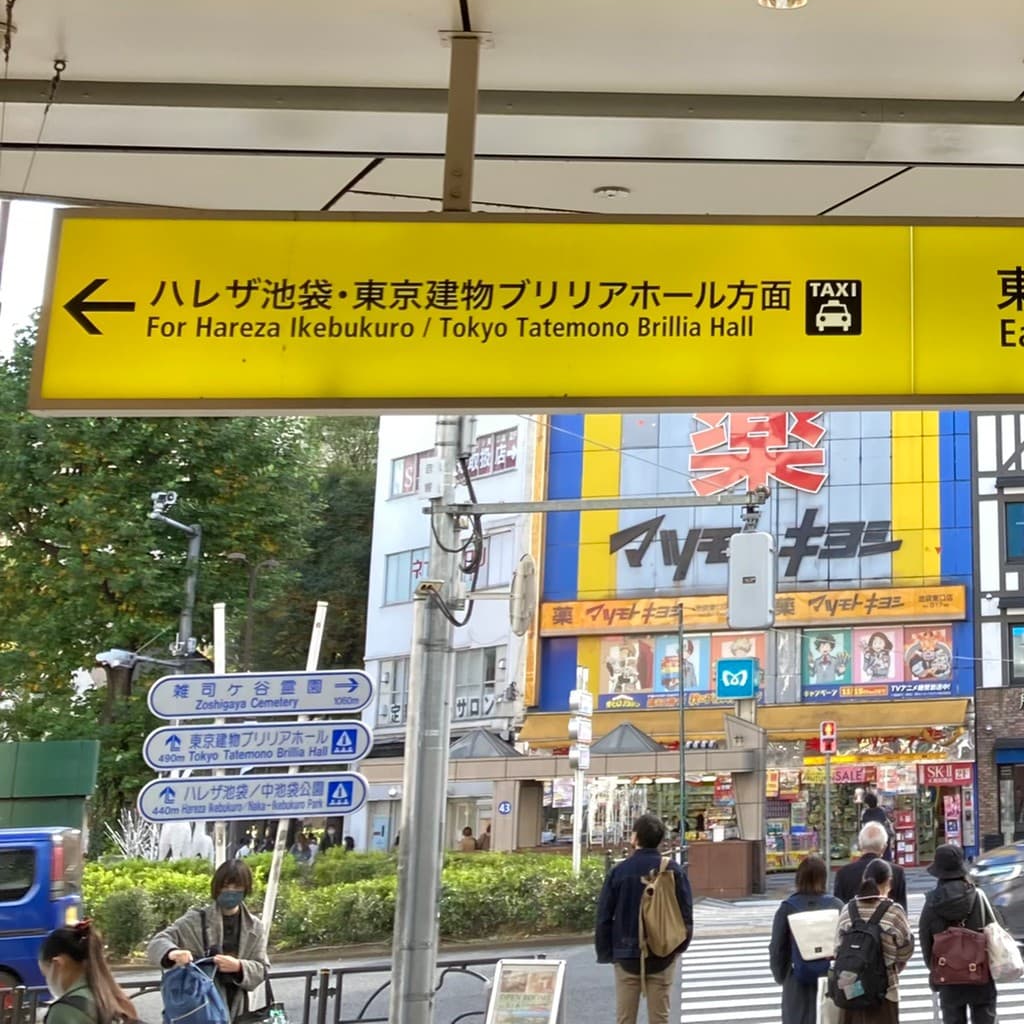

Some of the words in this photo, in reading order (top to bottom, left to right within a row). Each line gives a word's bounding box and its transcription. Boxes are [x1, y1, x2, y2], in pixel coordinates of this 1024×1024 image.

[809, 283, 857, 298] TAXI
[146, 316, 186, 337] For
[195, 316, 280, 338] Hareza
[290, 316, 414, 338] Ikebukuro
[440, 316, 508, 343] Tokyo
[516, 317, 629, 338] Tatemono
[637, 316, 701, 338] Brillia
[710, 316, 753, 337] Hall
[609, 508, 903, 582] マツモキヨシ
[808, 593, 905, 617] マツモトキヨシ
[195, 699, 247, 711] Zoshigaya
[251, 696, 298, 708] Cemetery
[189, 750, 218, 763] Tokyo
[223, 749, 273, 760] Tatemono
[308, 746, 328, 757] Hall
[835, 770, 864, 781] SALE
